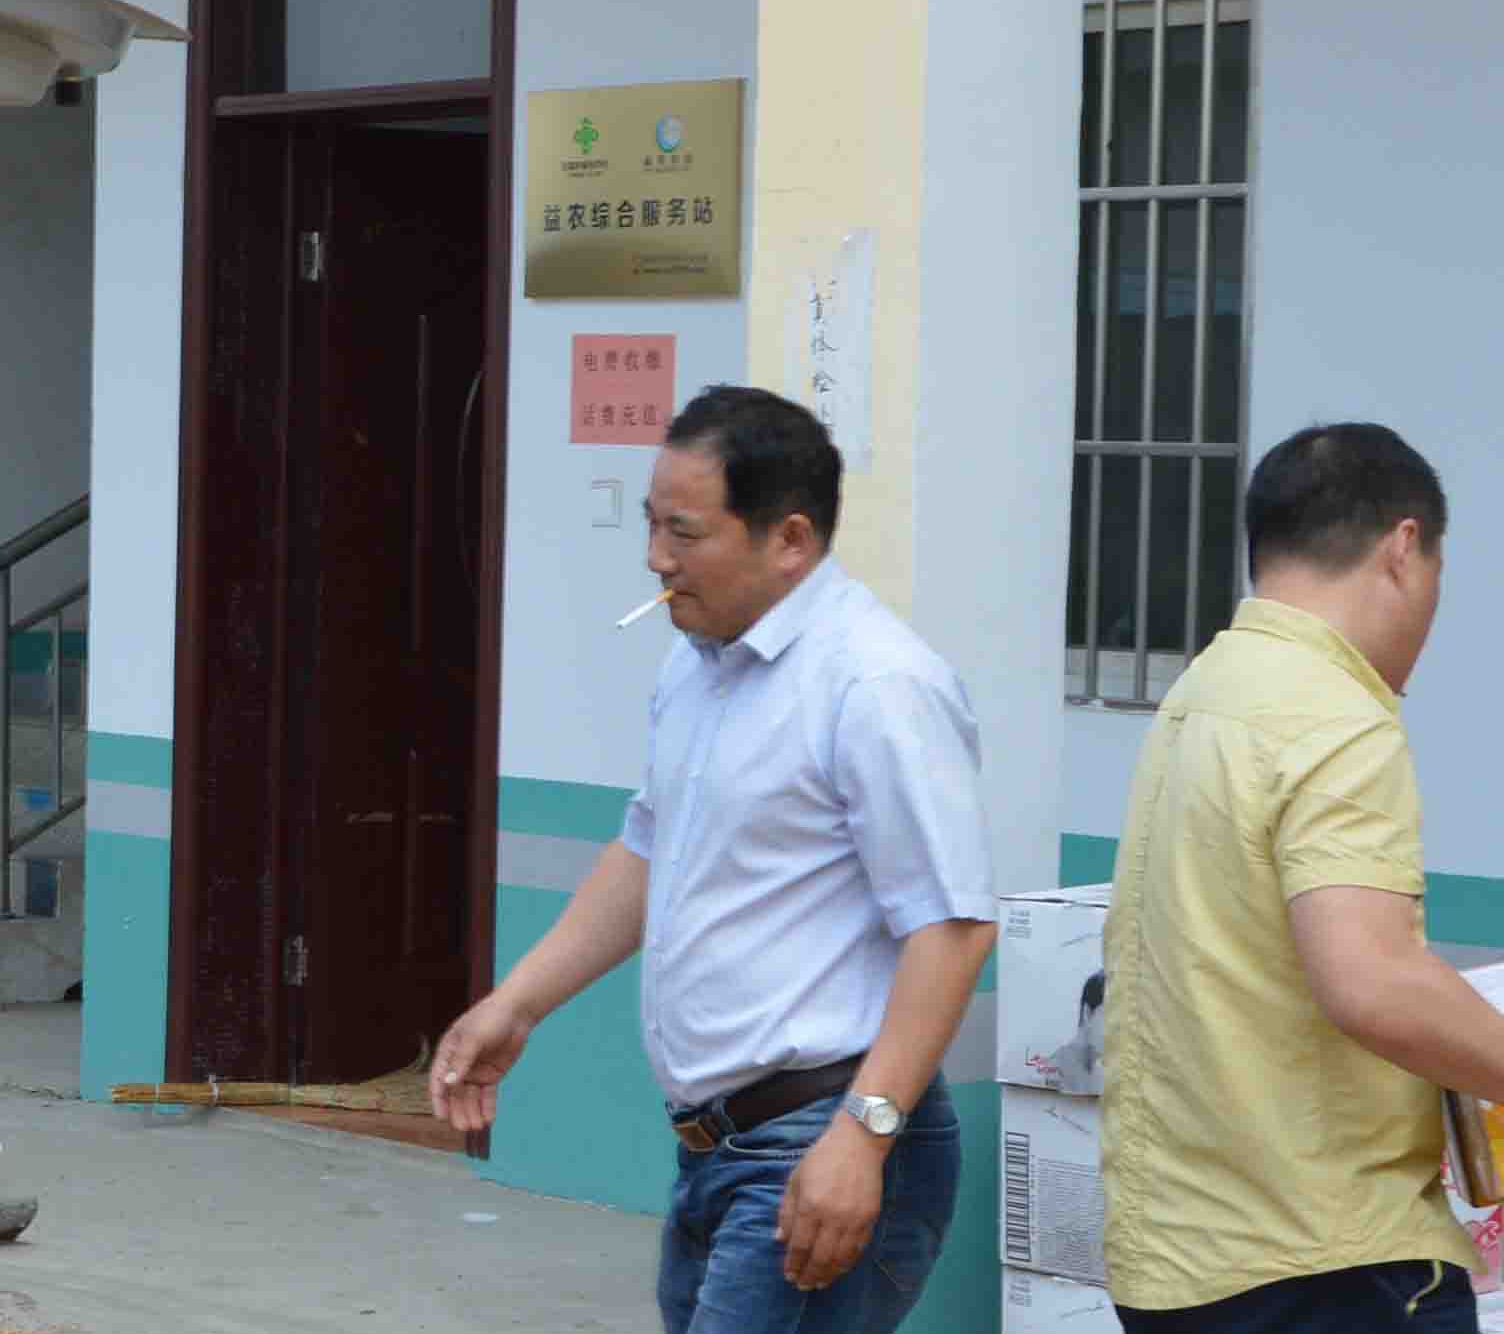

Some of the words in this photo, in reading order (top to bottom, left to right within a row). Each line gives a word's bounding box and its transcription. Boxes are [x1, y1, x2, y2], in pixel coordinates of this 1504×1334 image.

[543, 196, 714, 232] 益农综合服务站
